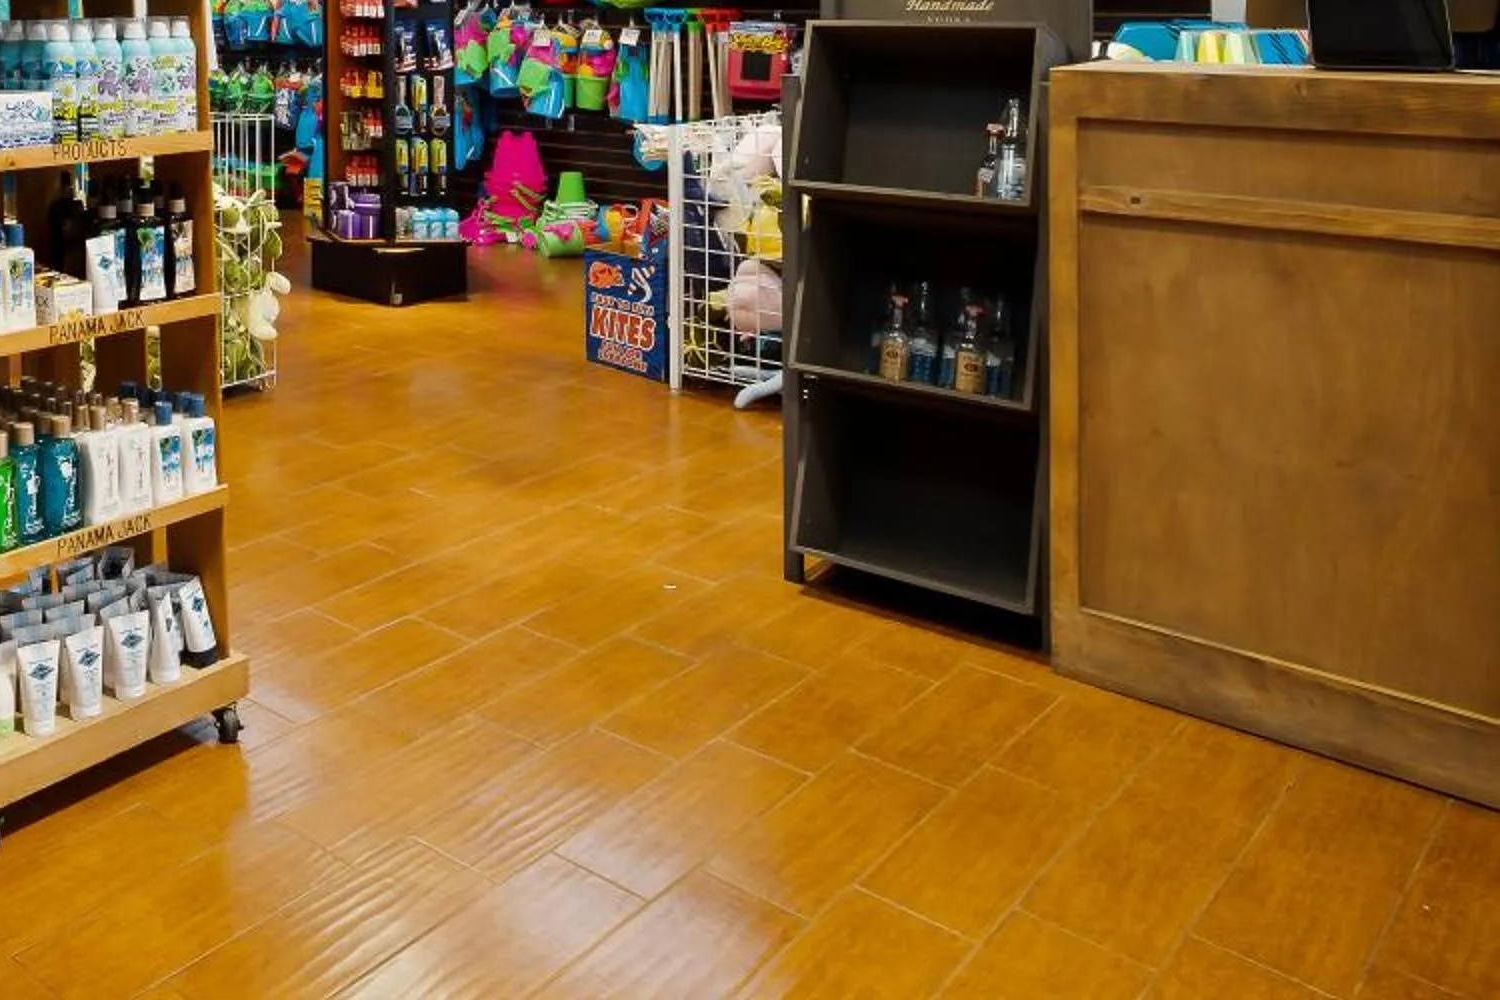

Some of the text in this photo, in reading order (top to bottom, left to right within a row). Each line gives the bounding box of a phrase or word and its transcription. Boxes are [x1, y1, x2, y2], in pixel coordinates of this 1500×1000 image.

[53, 139, 128, 161] PRODUCTS
[50, 309, 146, 344] PANAMA JACK
[590, 306, 657, 352] KITES
[57, 514, 152, 556] PANAMA JACK
